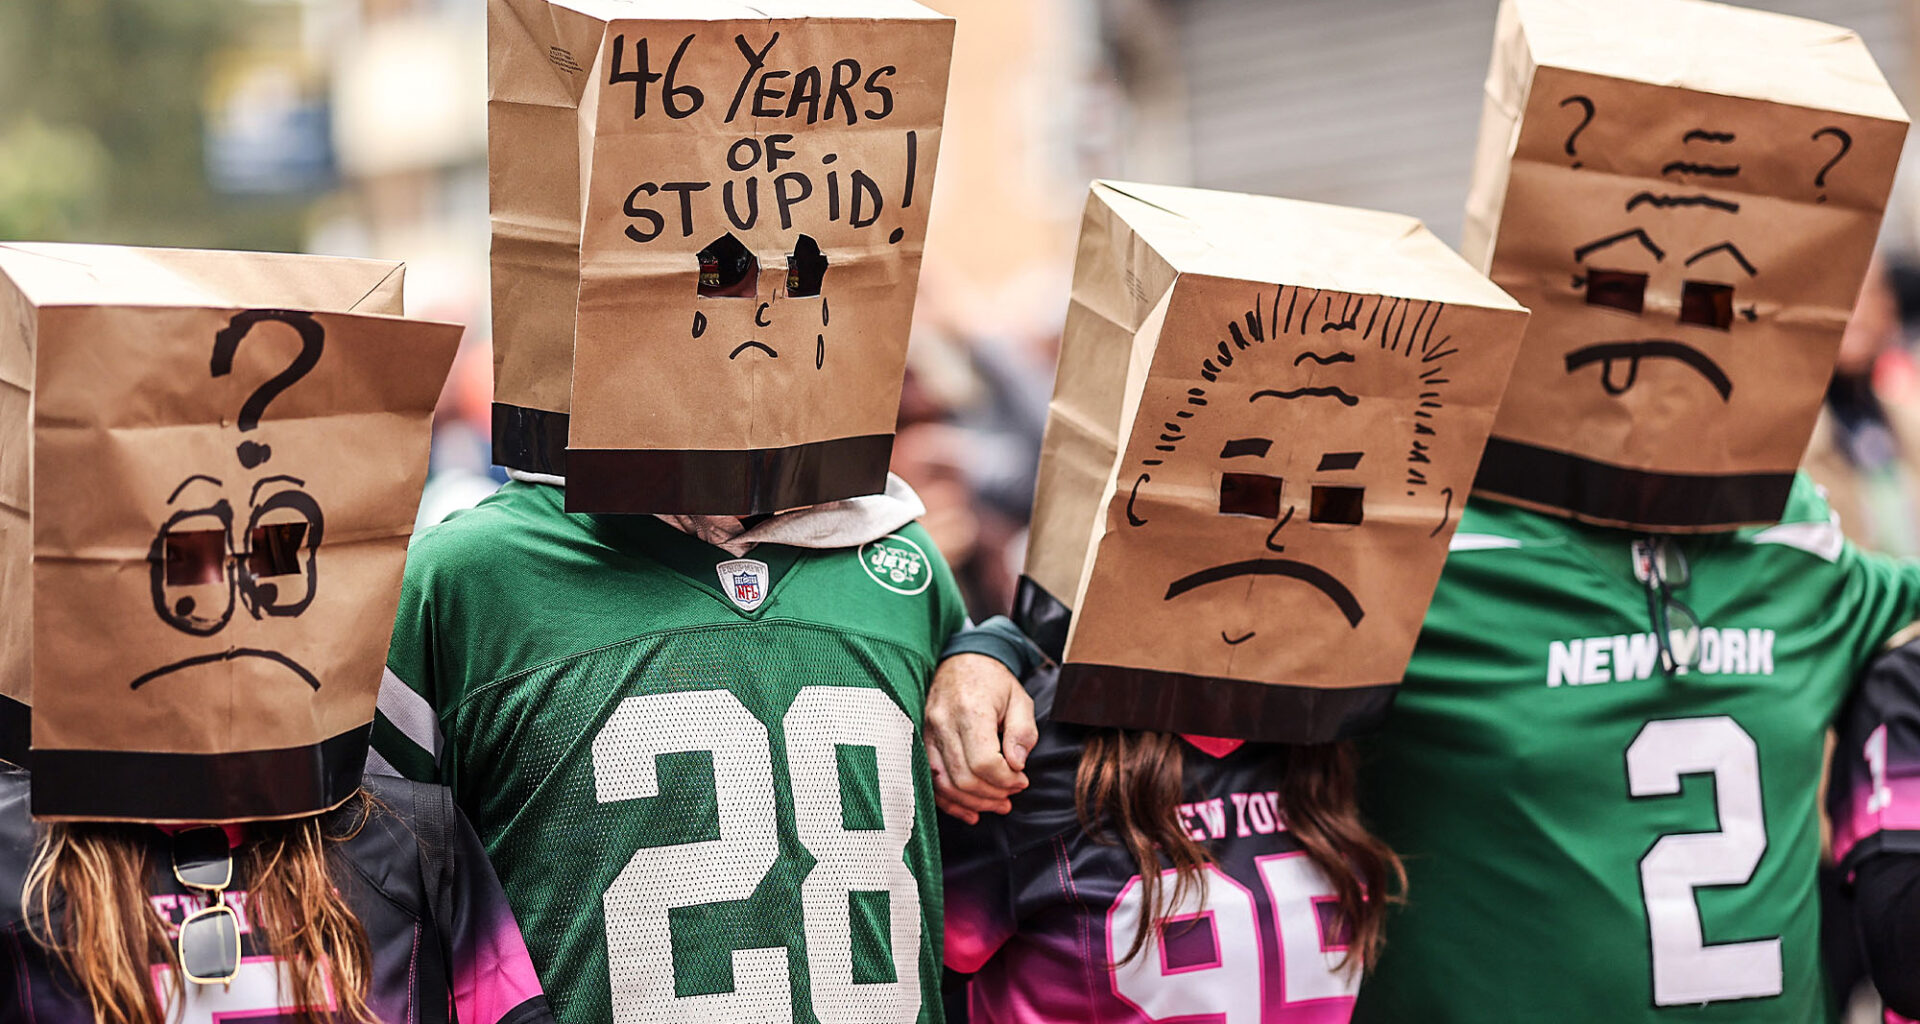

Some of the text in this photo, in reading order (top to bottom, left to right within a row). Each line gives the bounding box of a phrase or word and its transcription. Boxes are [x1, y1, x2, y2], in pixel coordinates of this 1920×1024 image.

[609, 31, 897, 125] 46 YEARS
[727, 134, 795, 172] OF
[871, 549, 921, 576] JETS
[736, 584, 760, 600] NFL
[1547, 626, 1775, 688] NEW YORK
[1174, 791, 1287, 841] EW YO
[592, 685, 922, 1024] 28
[1625, 714, 1784, 1008] 2
